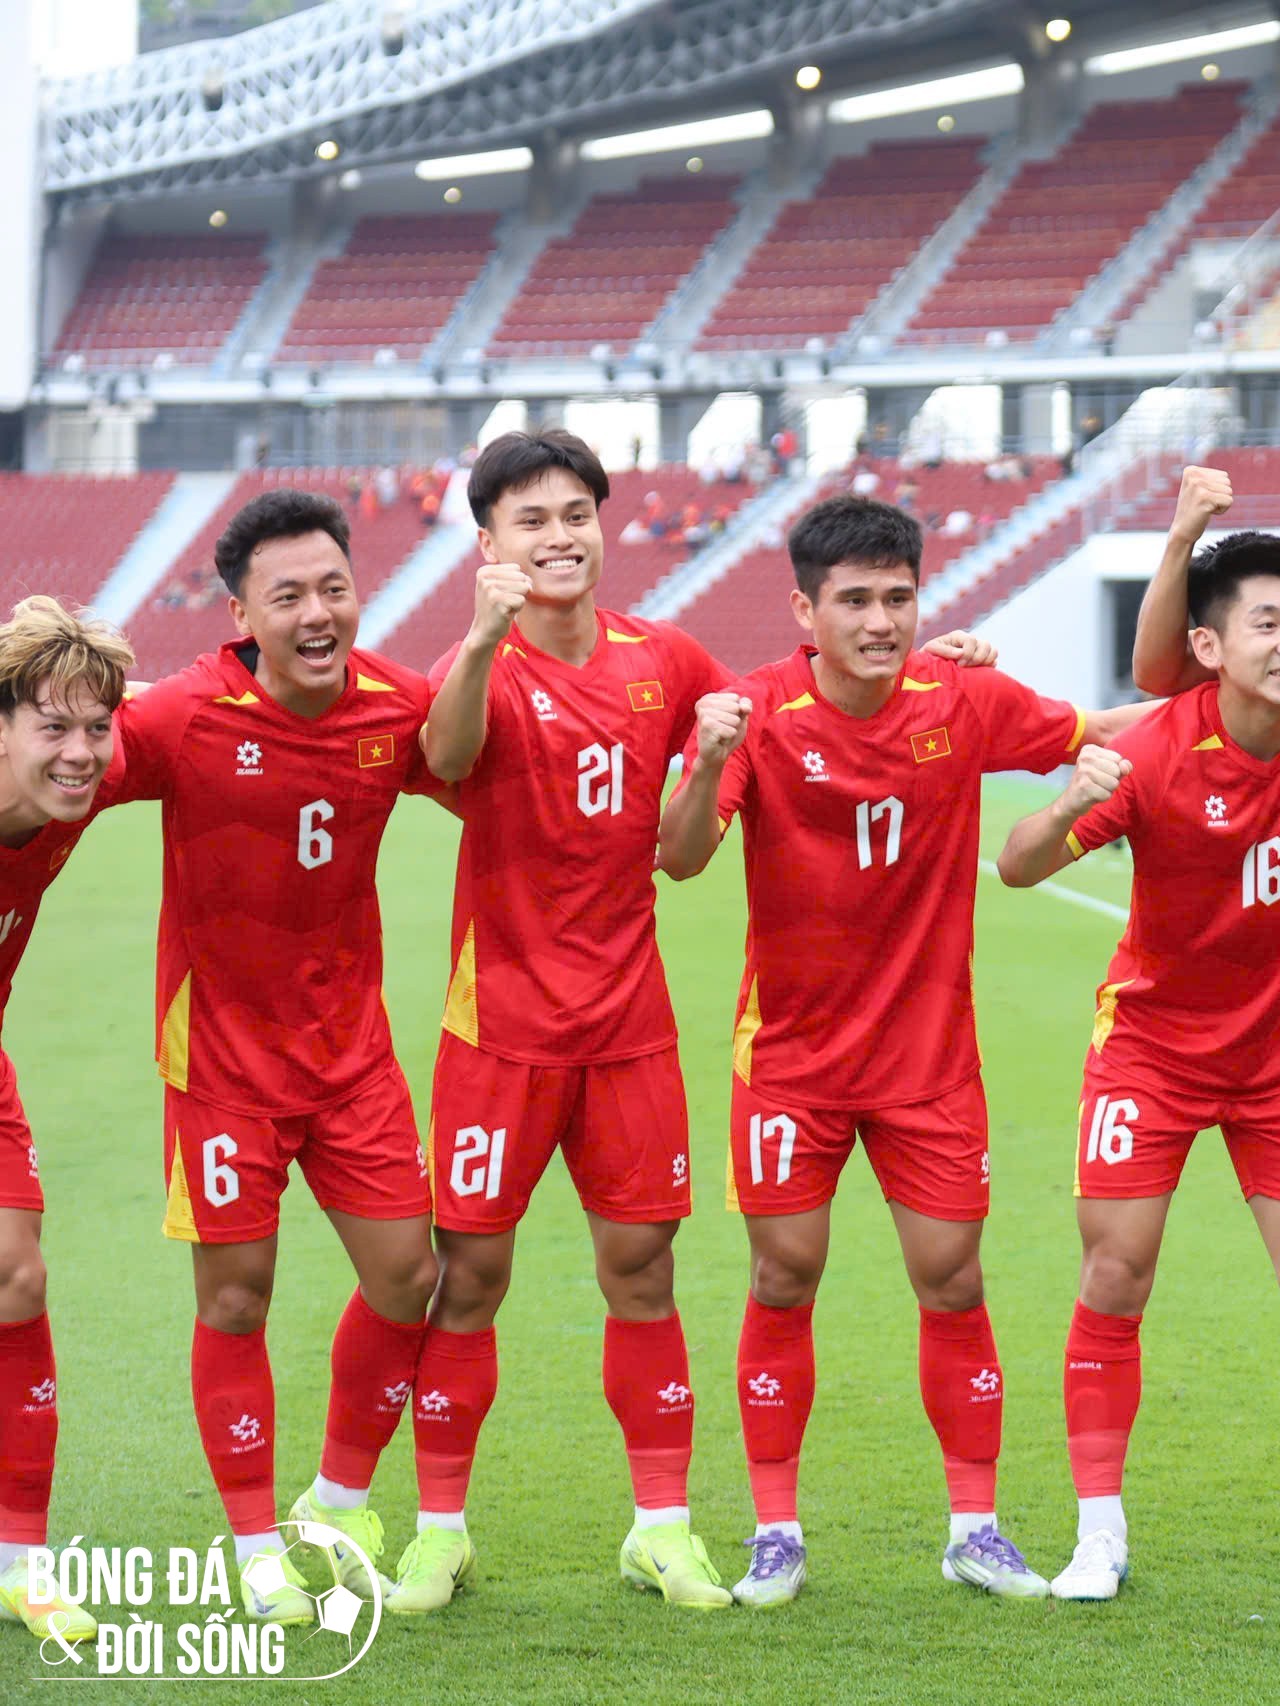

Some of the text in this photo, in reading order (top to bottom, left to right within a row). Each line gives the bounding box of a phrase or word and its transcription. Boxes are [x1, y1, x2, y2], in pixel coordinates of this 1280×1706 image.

[577, 742, 624, 817] 21
[297, 798, 335, 870] 6
[855, 795, 904, 870] 17
[449, 1125, 507, 1200] 21
[749, 1113, 797, 1185] 17
[1086, 1095, 1140, 1165] 16
[202, 1133, 240, 1208] 6
